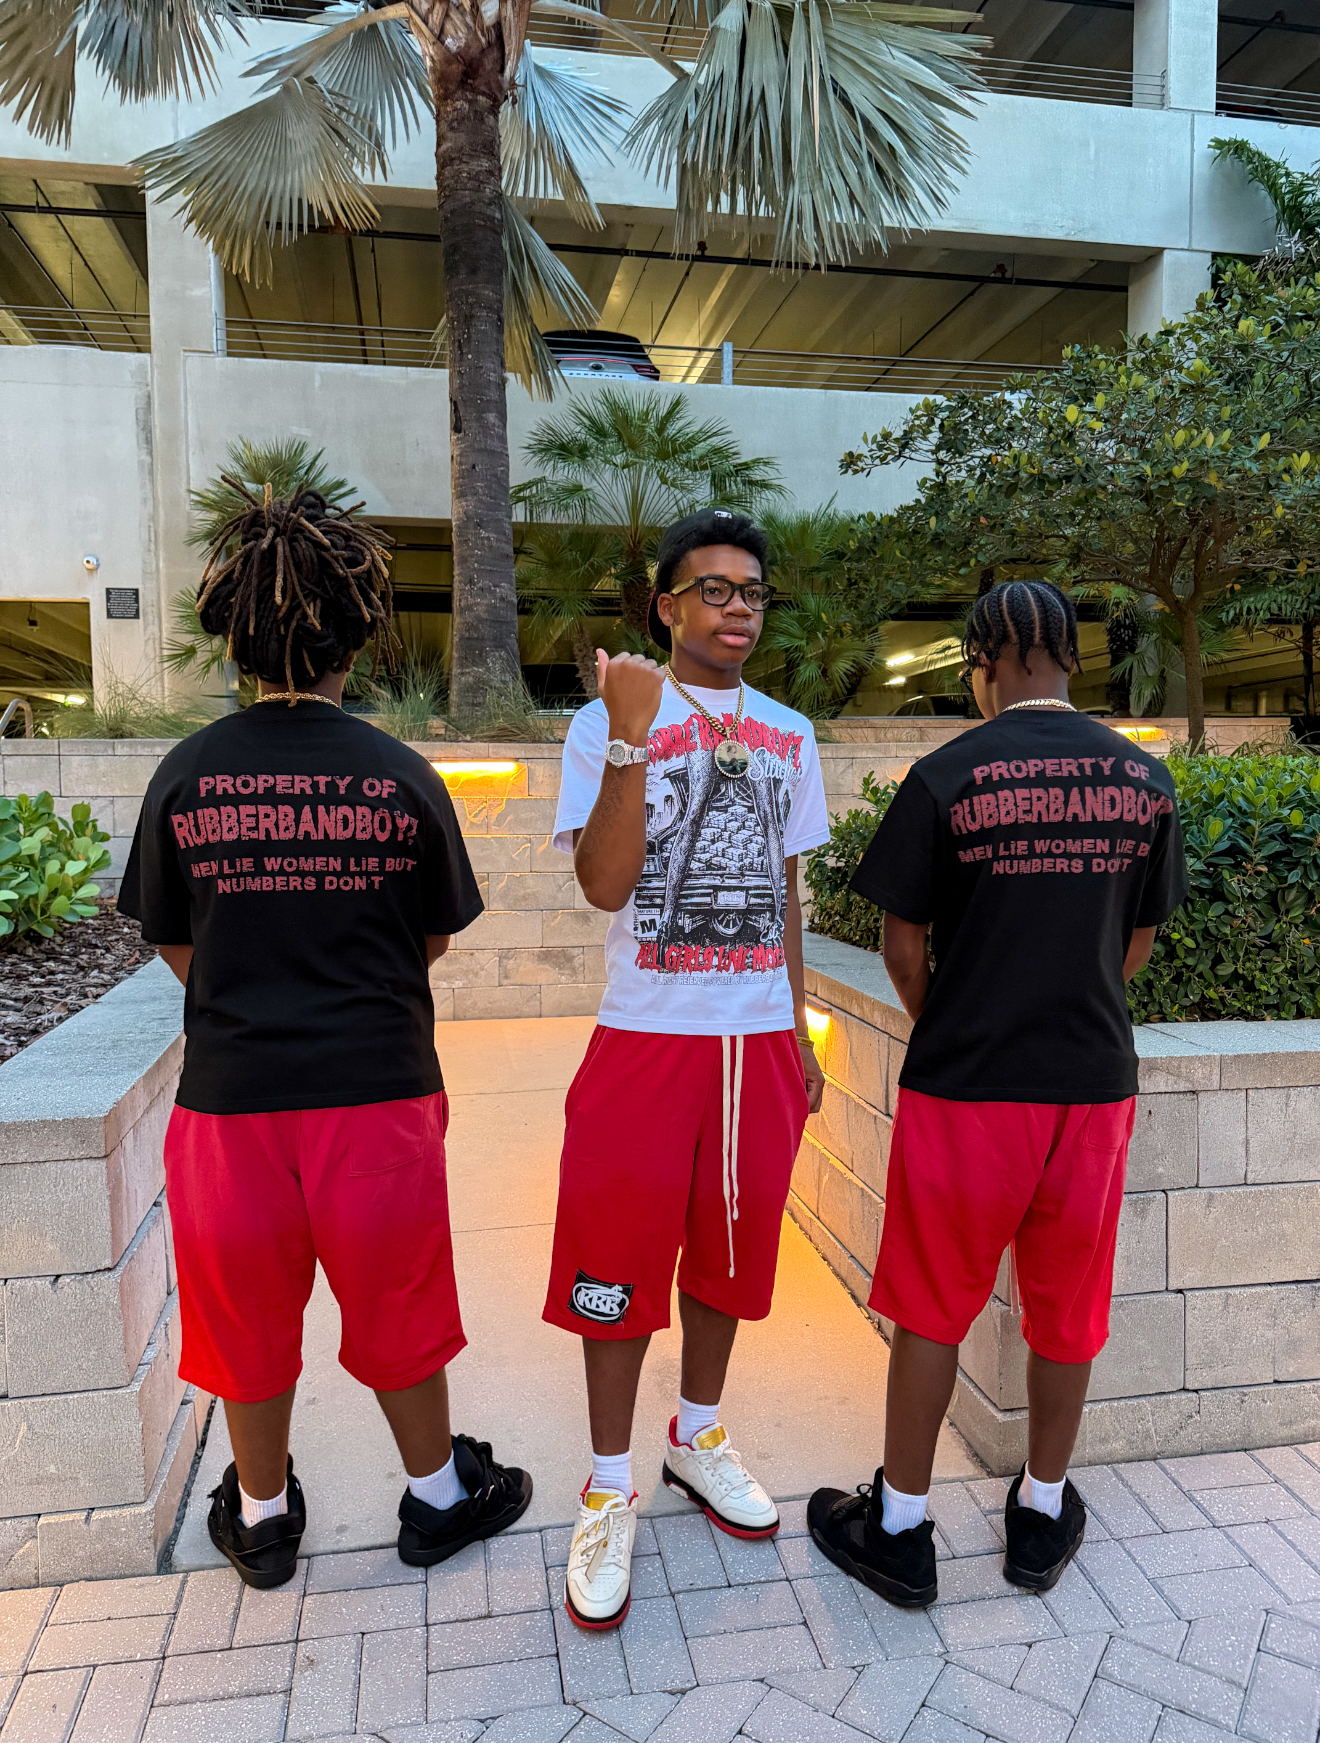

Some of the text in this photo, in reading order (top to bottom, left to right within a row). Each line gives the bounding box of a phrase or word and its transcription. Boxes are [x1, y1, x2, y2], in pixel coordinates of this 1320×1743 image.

[972, 757, 1150, 786] PROPERTY OF
[198, 774, 397, 799] PROPERTY OF
[998, 841, 1029, 857] LIE
[1034, 839, 1110, 855] WOMEN
[1116, 839, 1137, 855] LIE
[190, 857, 417, 879] MEN LIE WOMEN LIE BUT
[992, 858, 1085, 876] NUMBERS
[217, 875, 384, 894] NUMBERS DON'T
[640, 918, 658, 934] M
[634, 943, 662, 973] ALL
[664, 945, 715, 975] GIRLS
